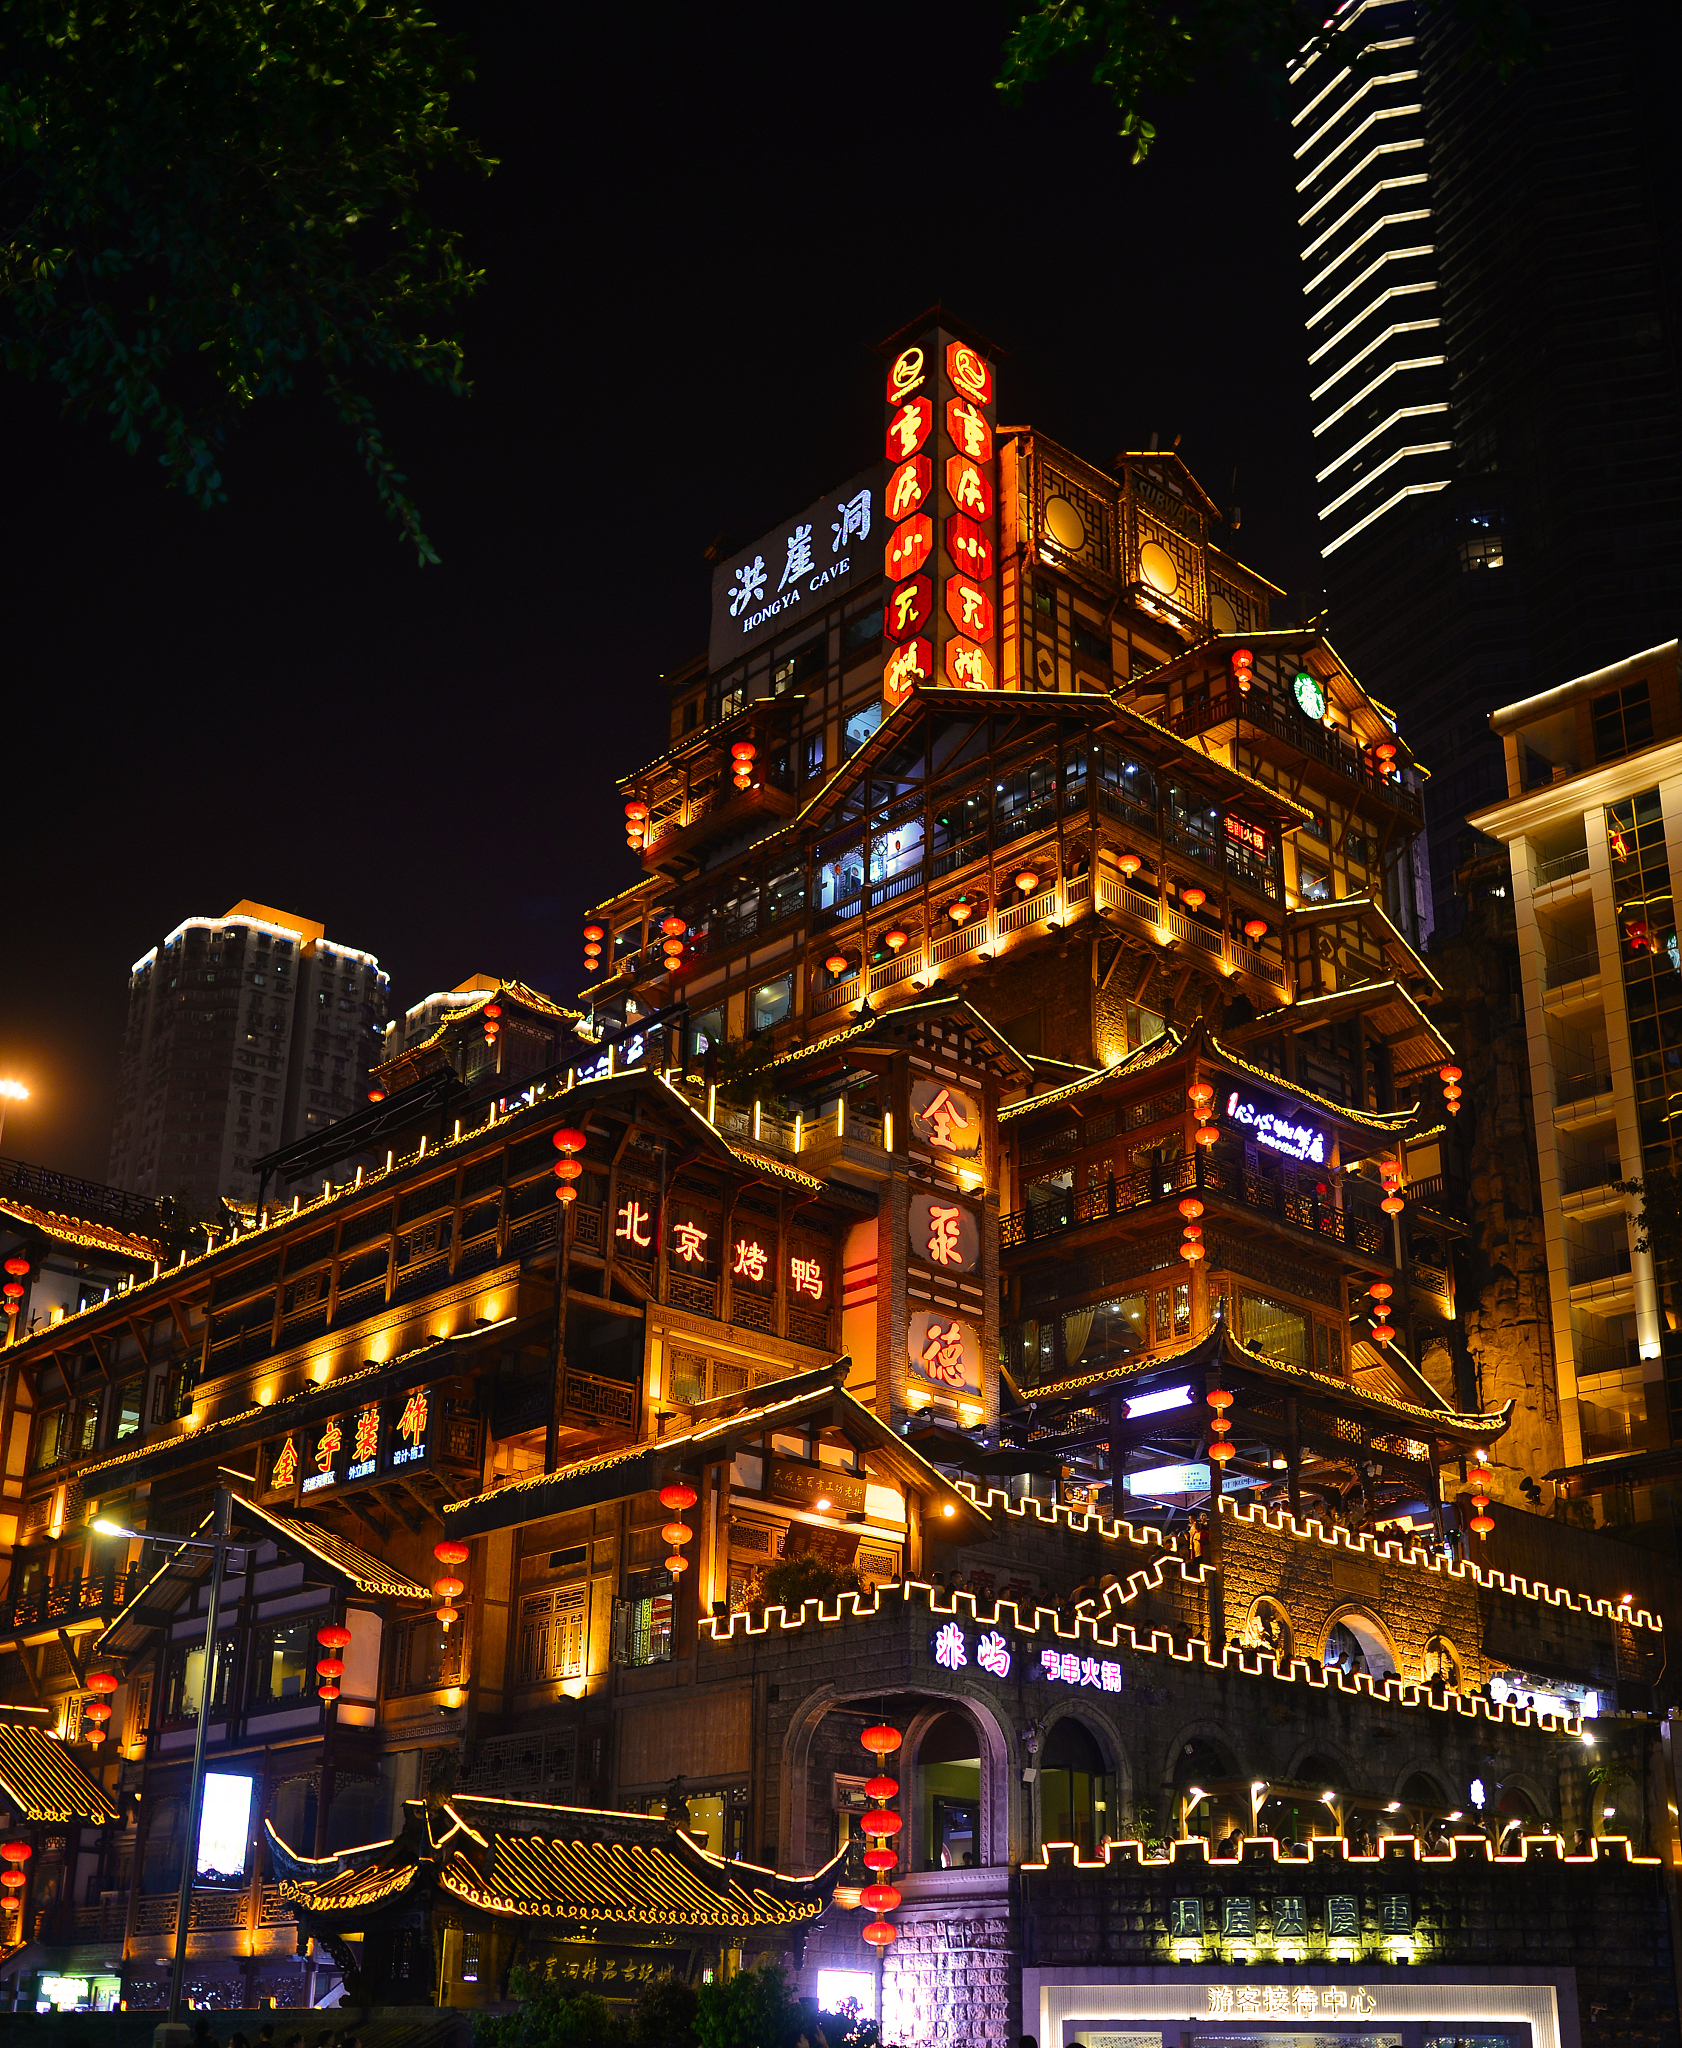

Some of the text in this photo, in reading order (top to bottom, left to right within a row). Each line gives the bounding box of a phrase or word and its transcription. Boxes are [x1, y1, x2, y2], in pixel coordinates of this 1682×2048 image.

[1138, 481, 1199, 524] SUBWAY
[728, 489, 872, 617] 洪崖洞
[742, 557, 850, 633] HONGYA CAVE
[615, 1201, 823, 1300] 北京烤鸭
[921, 1088, 969, 1388] 全聚德
[1041, 1649, 1121, 1692] 串串火锅
[1208, 1986, 1376, 2013] 游客接待中心
